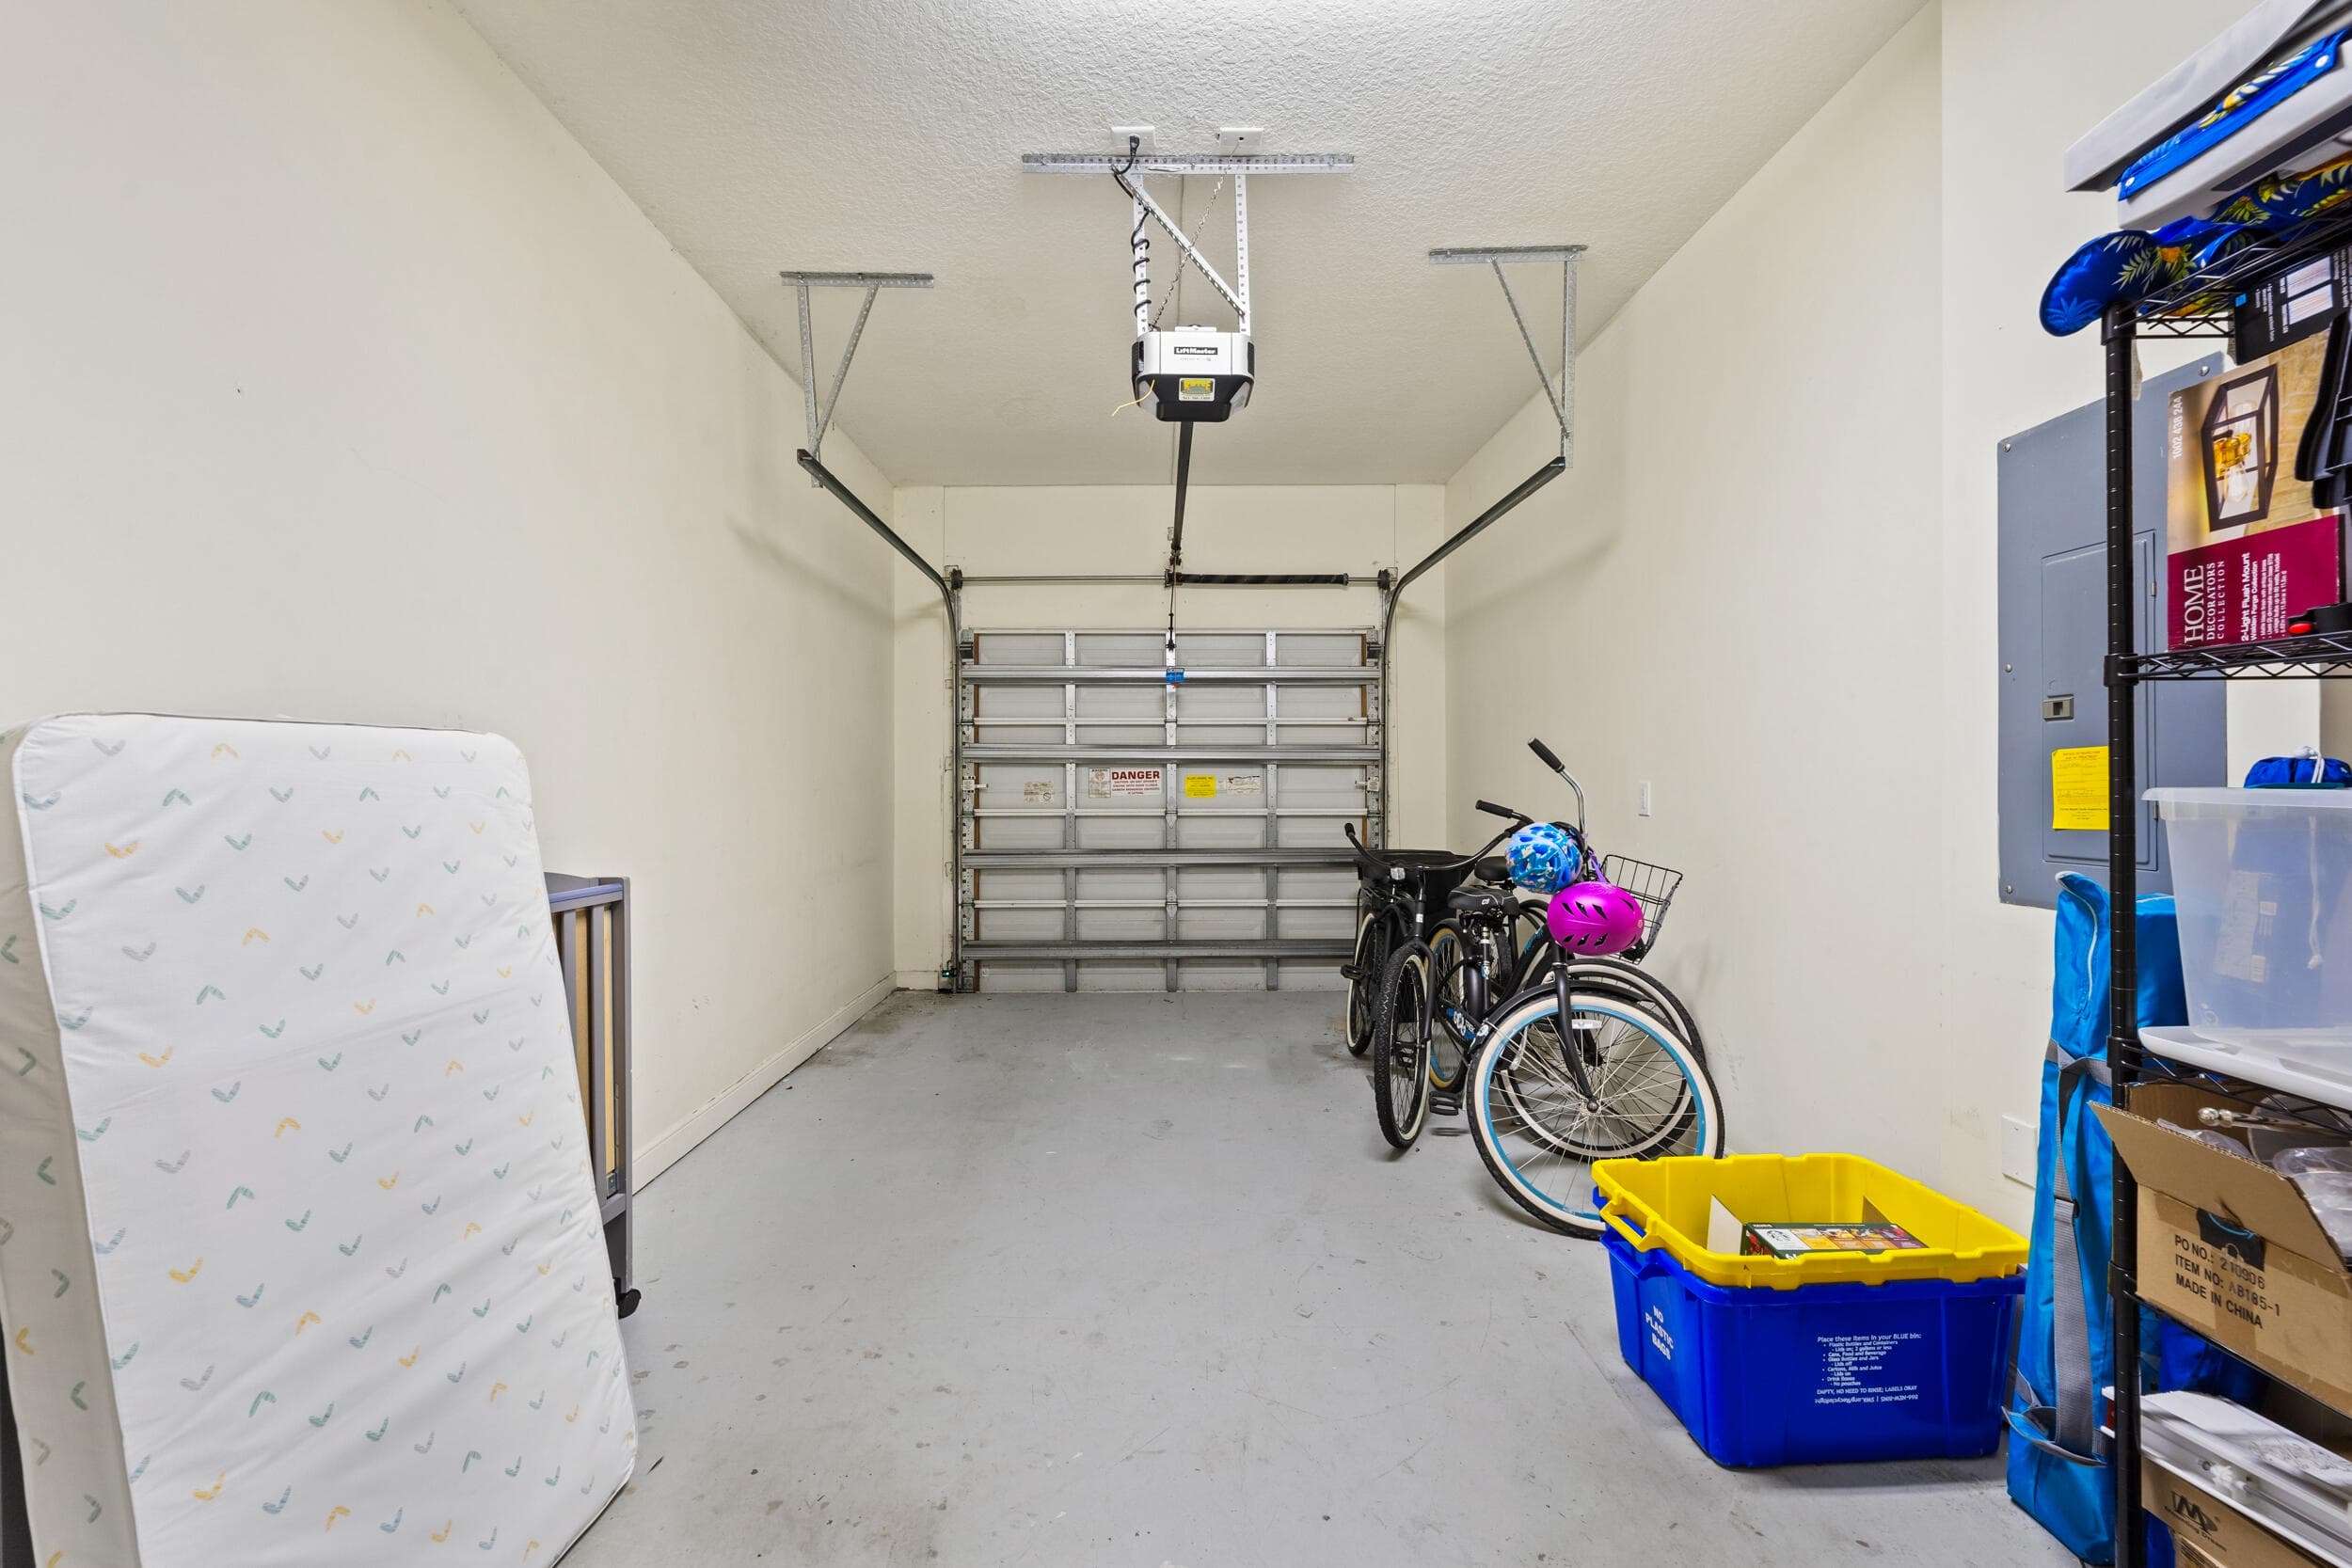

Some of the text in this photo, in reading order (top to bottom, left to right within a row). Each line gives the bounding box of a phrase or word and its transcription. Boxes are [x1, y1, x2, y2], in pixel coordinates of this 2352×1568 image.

[2173, 397, 2183, 415] 244
[2172, 436, 2183, 459] 1002
[2185, 565, 2204, 643] HOME
[2207, 562, 2216, 640] DECORATORS
[2241, 552, 2250, 641] 2-Light Flush Mount
[1112, 770, 1160, 780] DANGER
[2175, 1234, 2265, 1290] PO NO.: 210906
[2175, 1254, 2200, 1276] ITEM
[2204, 1268, 2224, 1289] NO:
[1653, 1305, 1663, 1323] NO
[2175, 1273, 2263, 1329] MADE IN CHINA
[1645, 1311, 1674, 1350] PLASTIC
